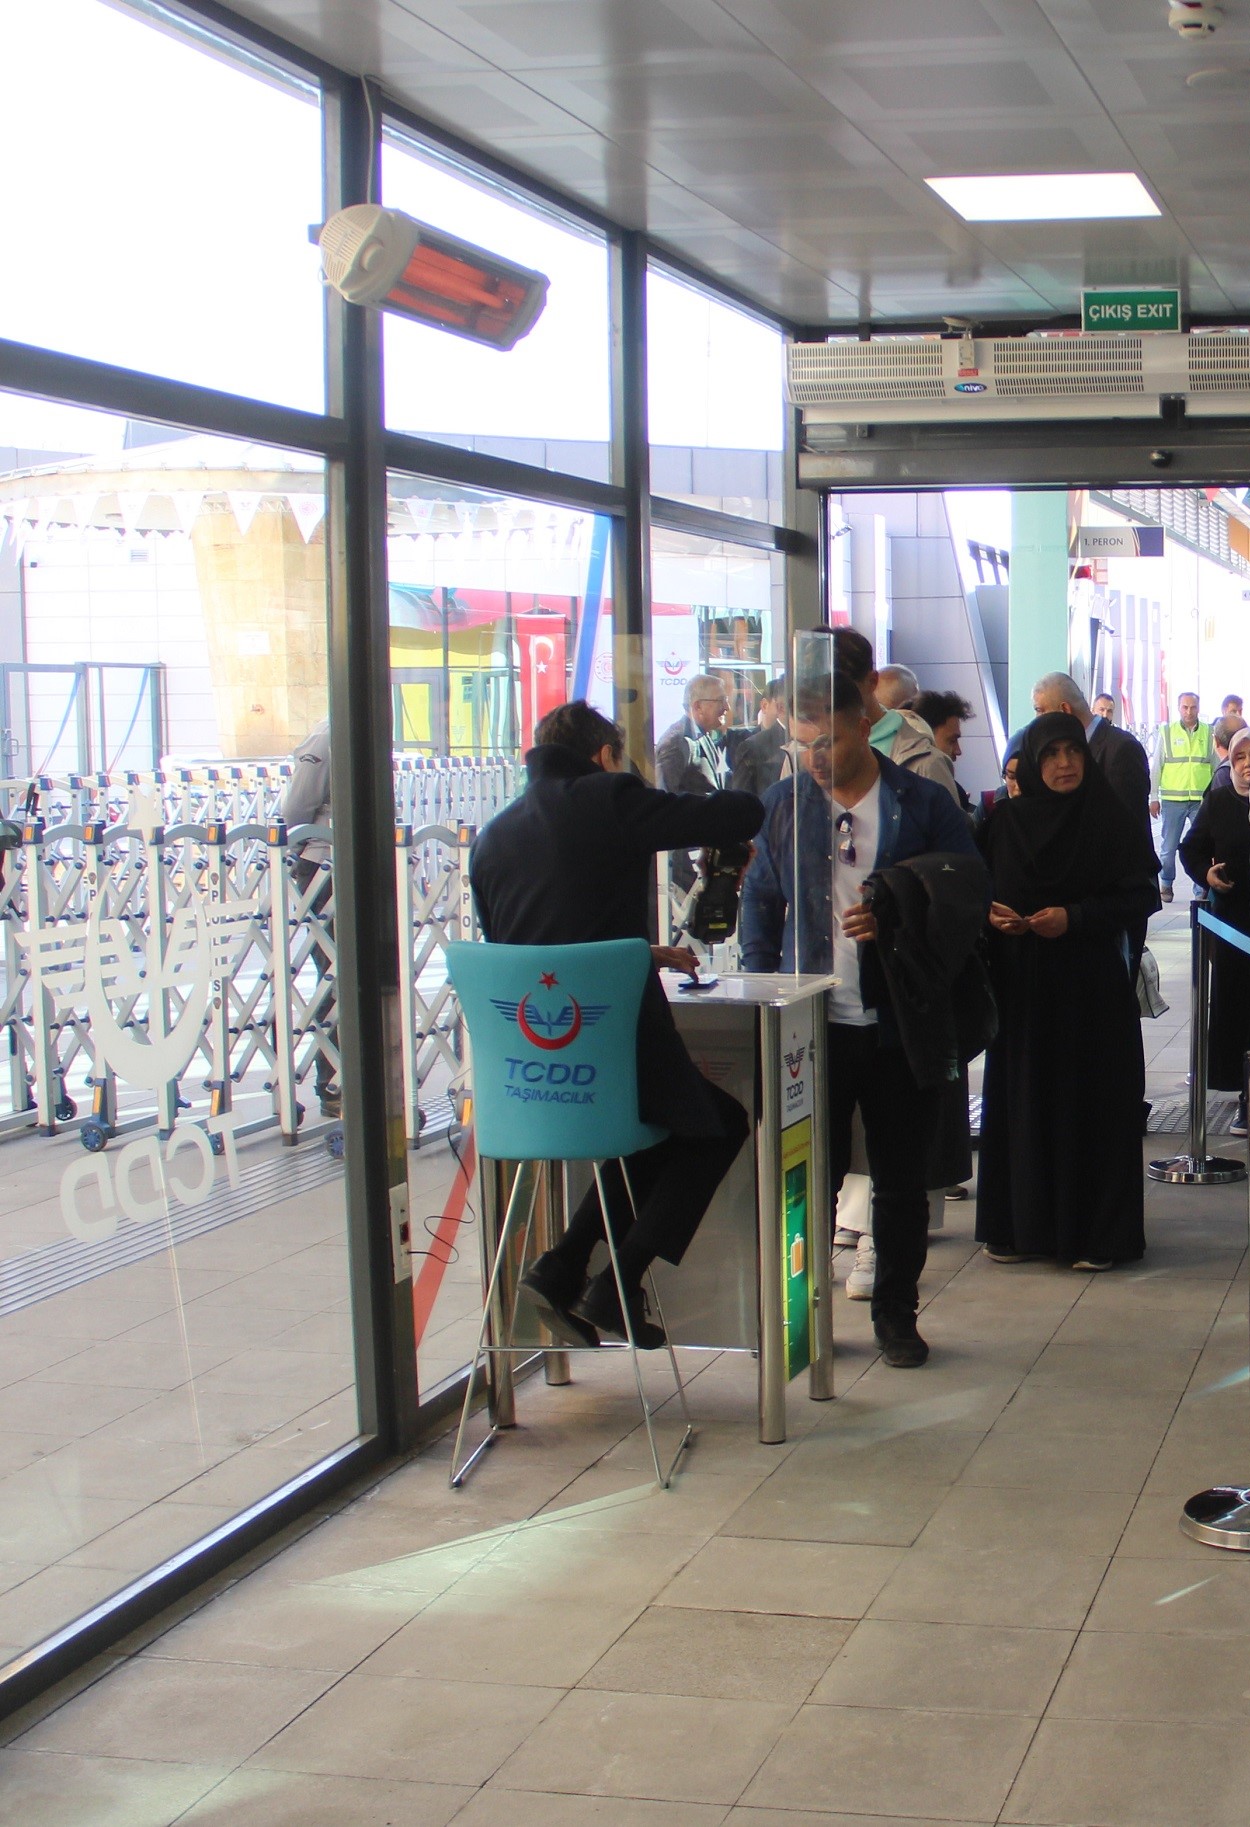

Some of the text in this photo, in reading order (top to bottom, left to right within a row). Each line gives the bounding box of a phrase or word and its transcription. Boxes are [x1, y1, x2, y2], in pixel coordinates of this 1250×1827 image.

[1088, 303, 1173, 321] ÇIKIŞ EXIT
[1092, 537, 1124, 546] PERON
[660, 678, 688, 686] TCDD
[504, 1057, 597, 1086] TCDD
[503, 1084, 597, 1104] TAŞIMACILIK
